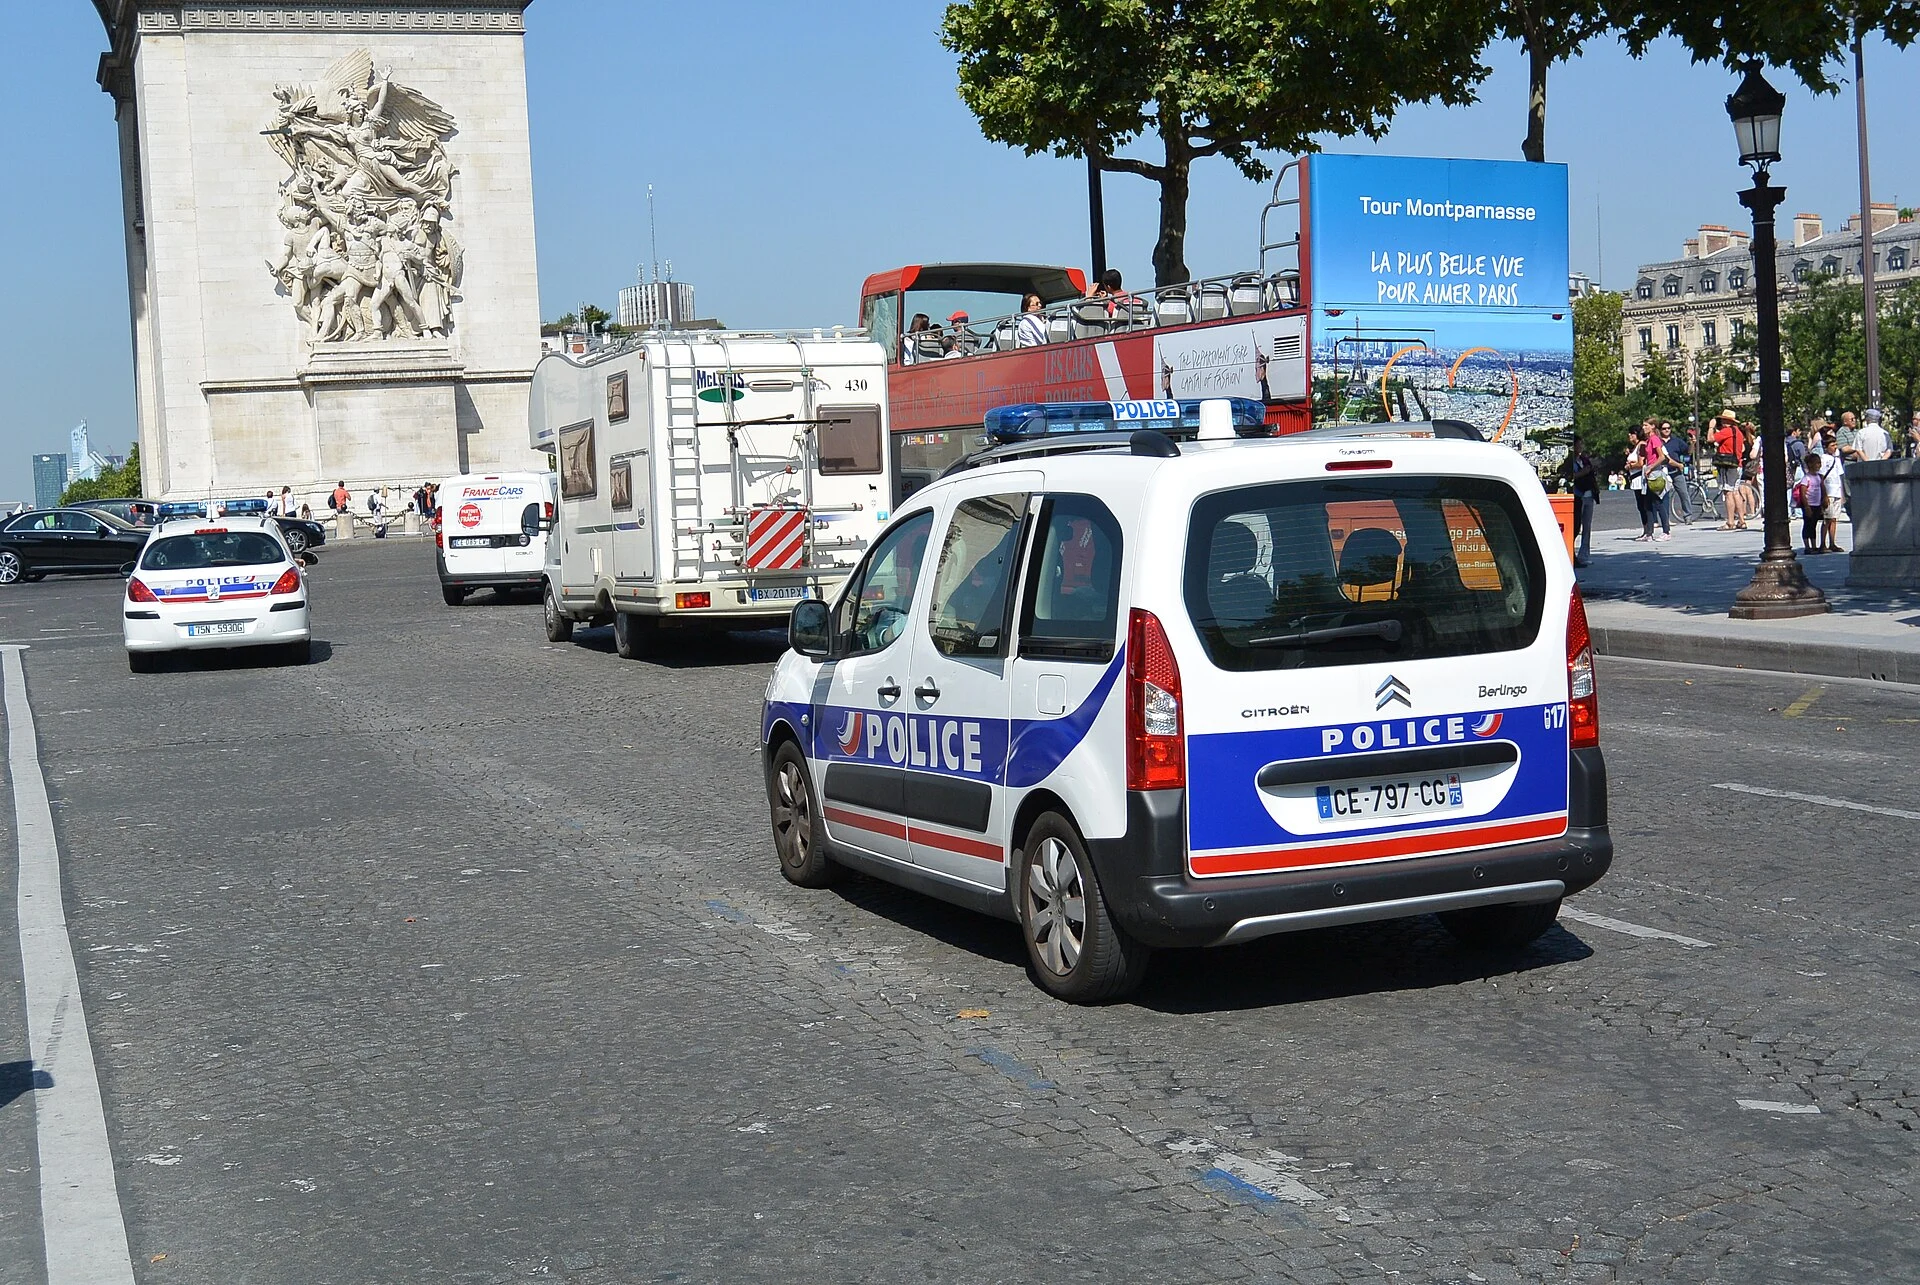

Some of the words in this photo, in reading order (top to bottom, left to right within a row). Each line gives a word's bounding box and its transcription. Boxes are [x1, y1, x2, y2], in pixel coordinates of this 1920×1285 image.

[1359, 196, 1402, 215] Tour
[1406, 198, 1536, 222] Montparnasse
[1370, 250, 1392, 274] LA
[1397, 251, 1433, 276] PLUS
[1439, 251, 1487, 278] BELLE
[1491, 254, 1525, 278] VUE
[1377, 281, 1420, 304] POUR
[1423, 281, 1474, 305] AIMER
[1478, 282, 1518, 306] PARIS
[844, 379, 868, 392] 430
[1115, 401, 1177, 419] POLICE
[186, 576, 240, 587] POLICE
[258, 582, 269, 590] 17
[757, 589, 770, 599] BX
[1478, 684, 1528, 698] Berlingo
[1241, 704, 1310, 718] CITROËN
[1550, 704, 1566, 729] 17
[866, 713, 982, 773] POLICE
[1321, 717, 1465, 753] POLICE
[1333, 779, 1446, 815] CE-797-CG
[1450, 790, 1462, 803] 75
